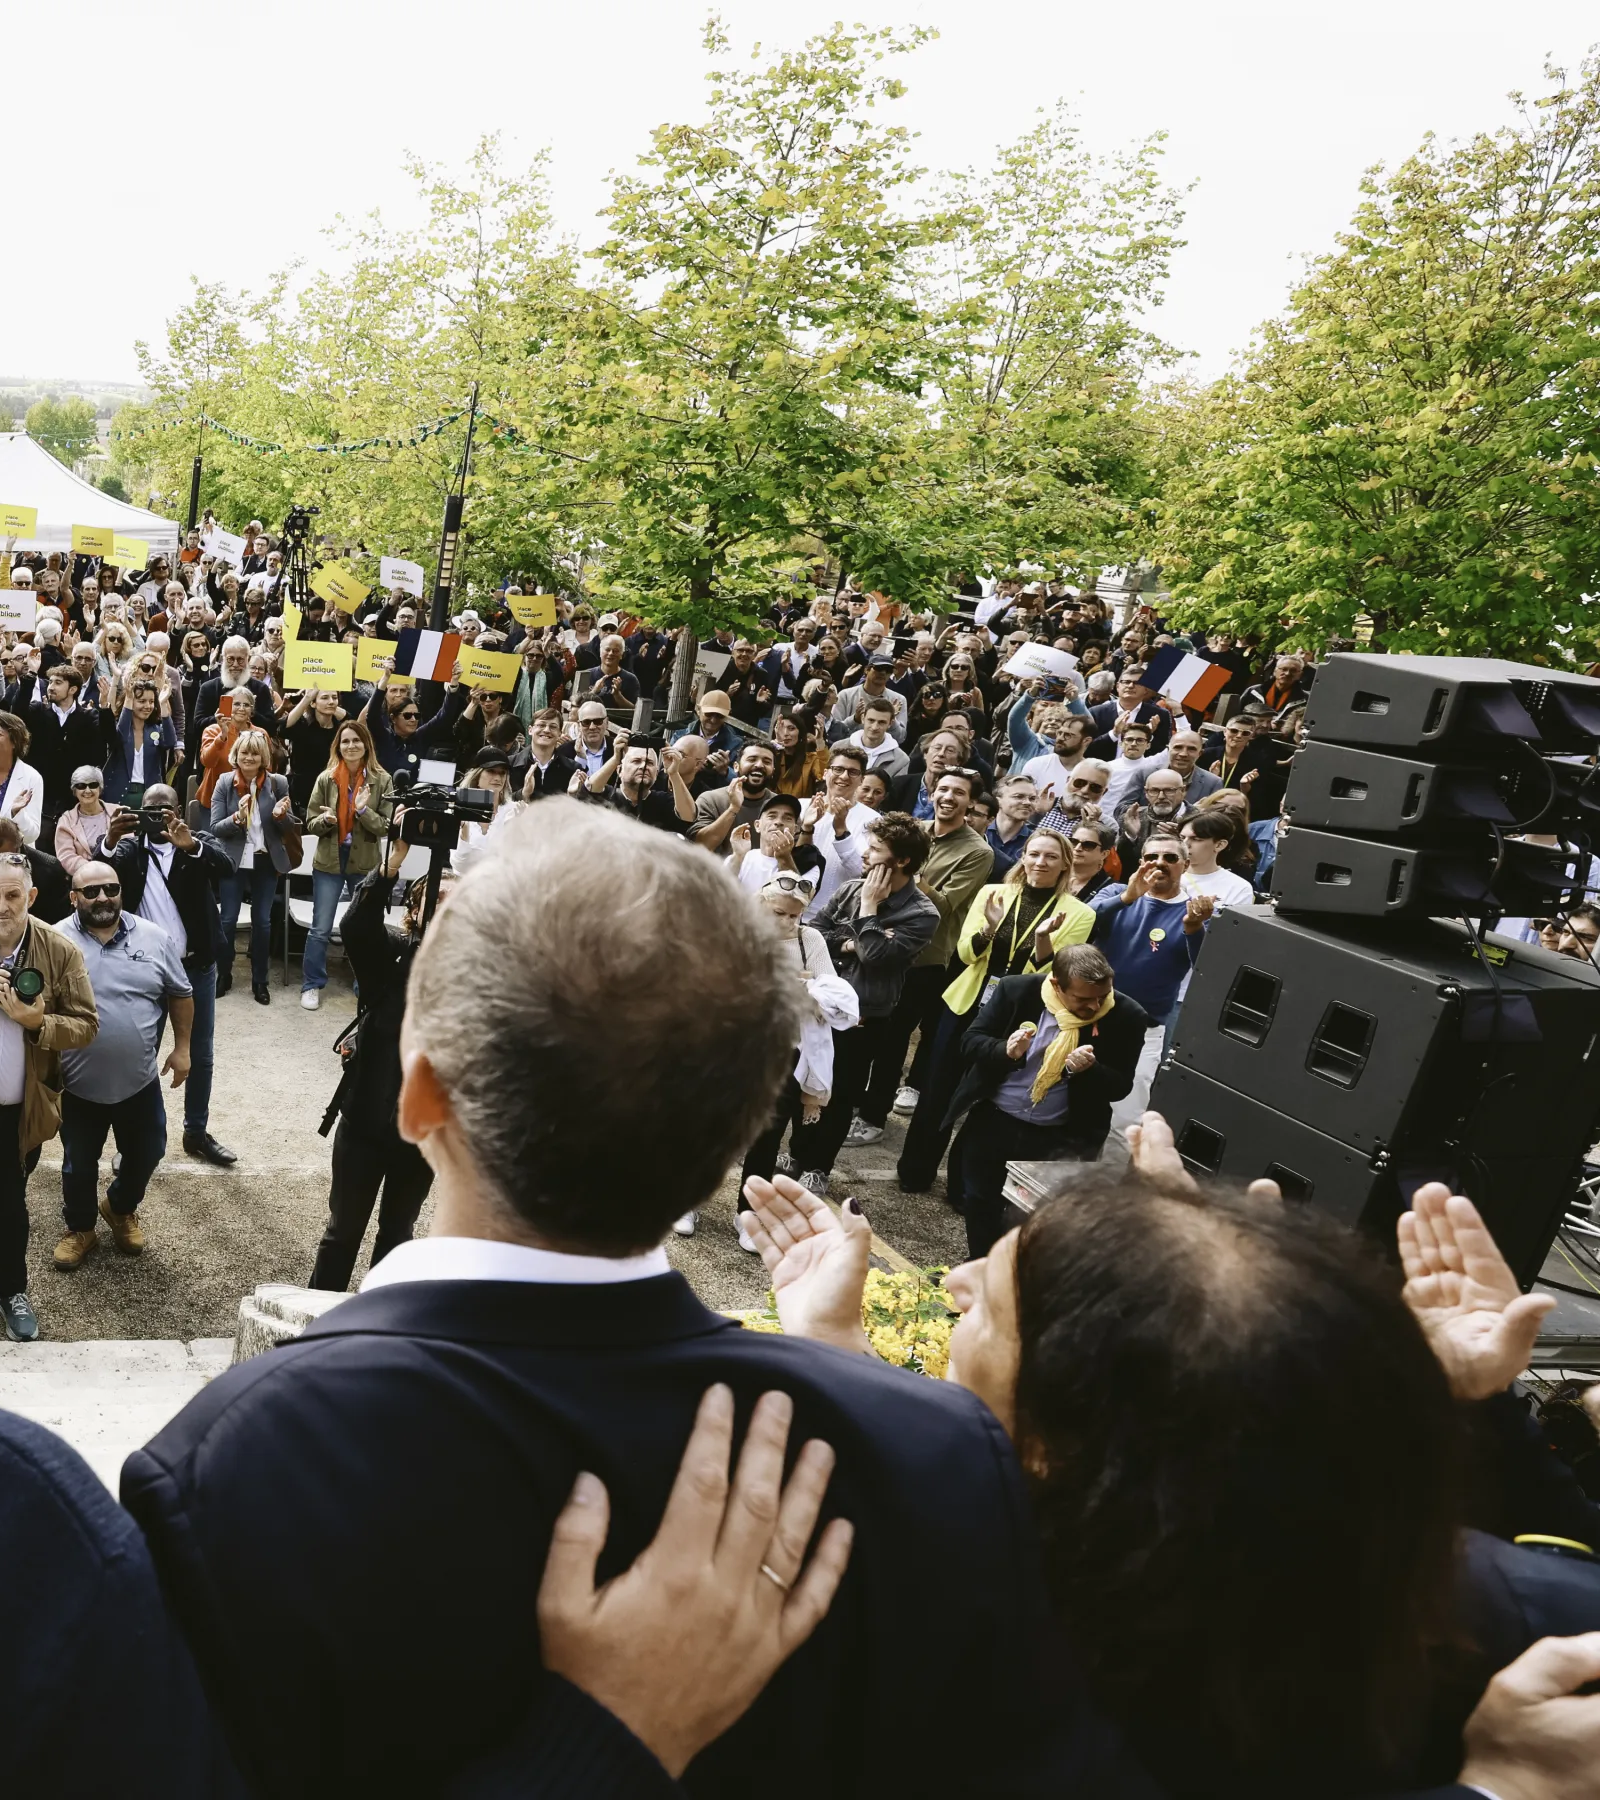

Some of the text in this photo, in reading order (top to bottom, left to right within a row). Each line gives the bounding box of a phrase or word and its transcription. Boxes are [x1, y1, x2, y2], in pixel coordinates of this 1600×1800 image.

[330, 578, 345, 590] place
[326, 583, 349, 600] publique
[302, 656, 323, 665] place
[372, 653, 388, 661] plac
[1028, 654, 1047, 664] place
[302, 666, 335, 674] publique
[471, 661, 491, 670] place
[469, 668, 502, 679] publique
[695, 668, 713, 676] blique
